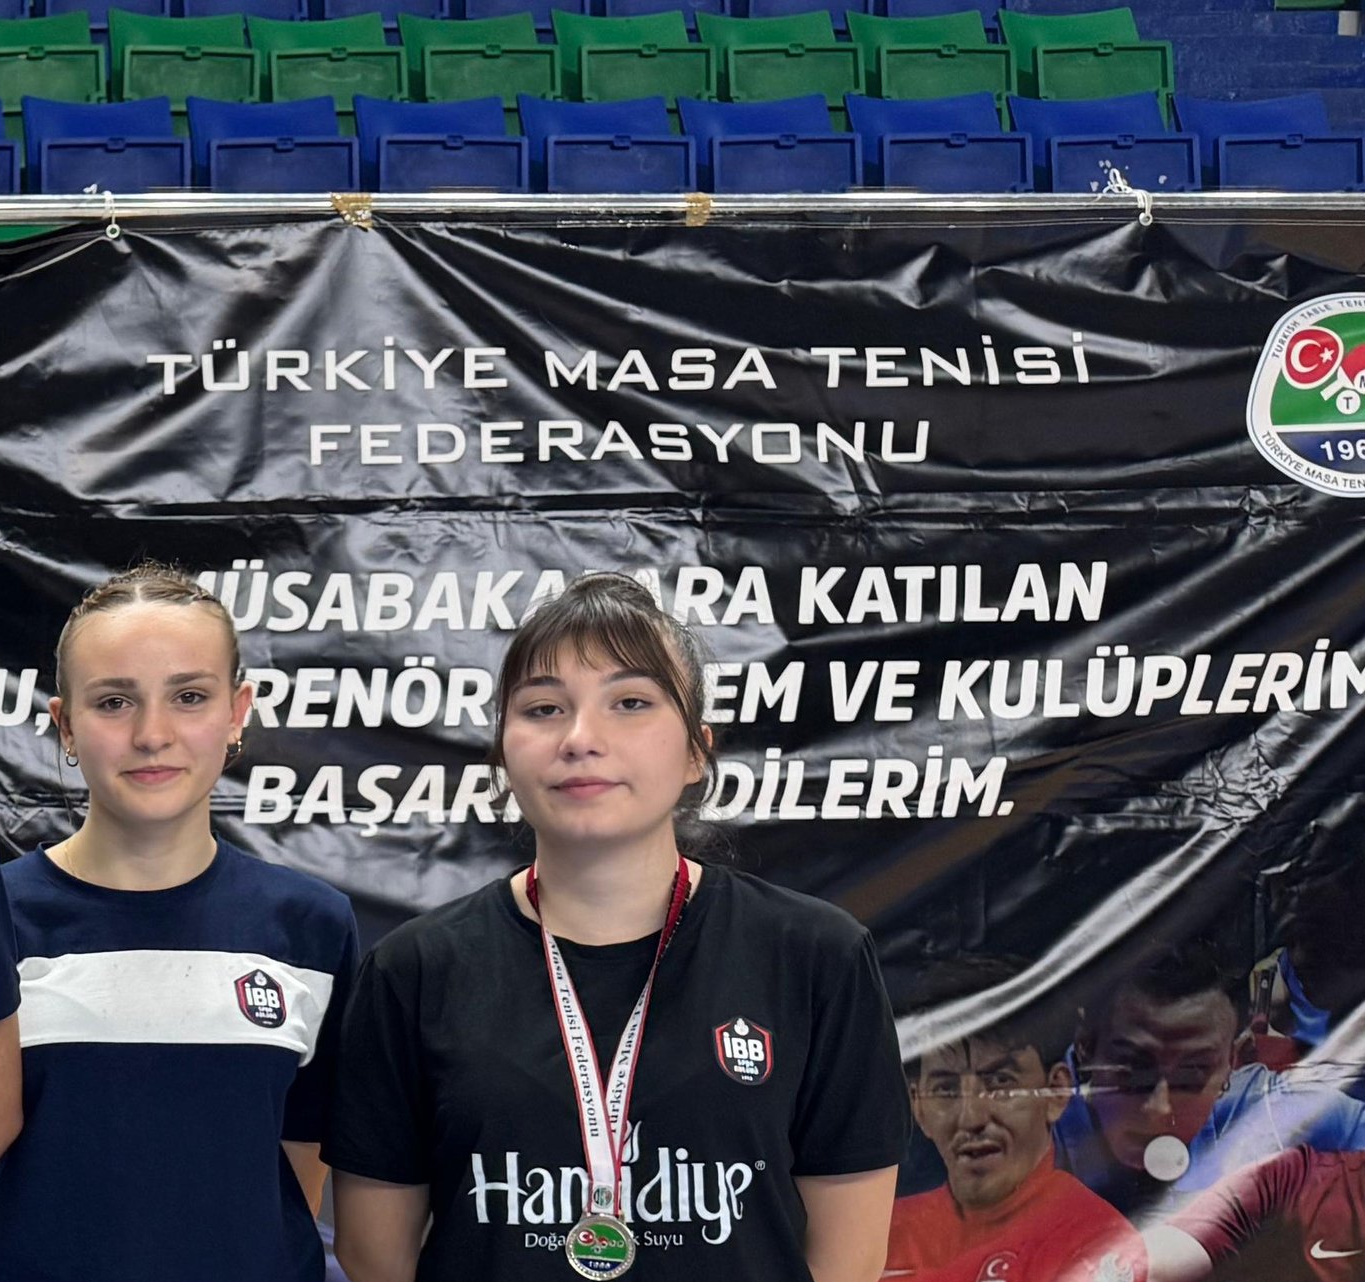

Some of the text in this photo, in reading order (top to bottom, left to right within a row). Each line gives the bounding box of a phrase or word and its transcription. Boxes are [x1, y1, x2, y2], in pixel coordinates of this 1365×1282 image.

[1272, 299, 1365, 358] TURKISH TABLE TEN
[147, 331, 1091, 396] TÜRKİYE MASA TENİSİ
[308, 418, 931, 467] FEDERASYONU
[1261, 430, 1303, 472] TÜRKİYE
[1304, 466, 1339, 486] MASA
[195, 558, 1107, 632] ÜSABAKARA KATILAN
[243, 656, 494, 729] RENÖR
[829, 660, 919, 723] VE
[243, 764, 522, 837] BAŞAR
[572, 1034, 599, 1138] Federasyonu
[524, 1231, 567, 1250] Doğa
[643, 1231, 683, 1250] Suyu
